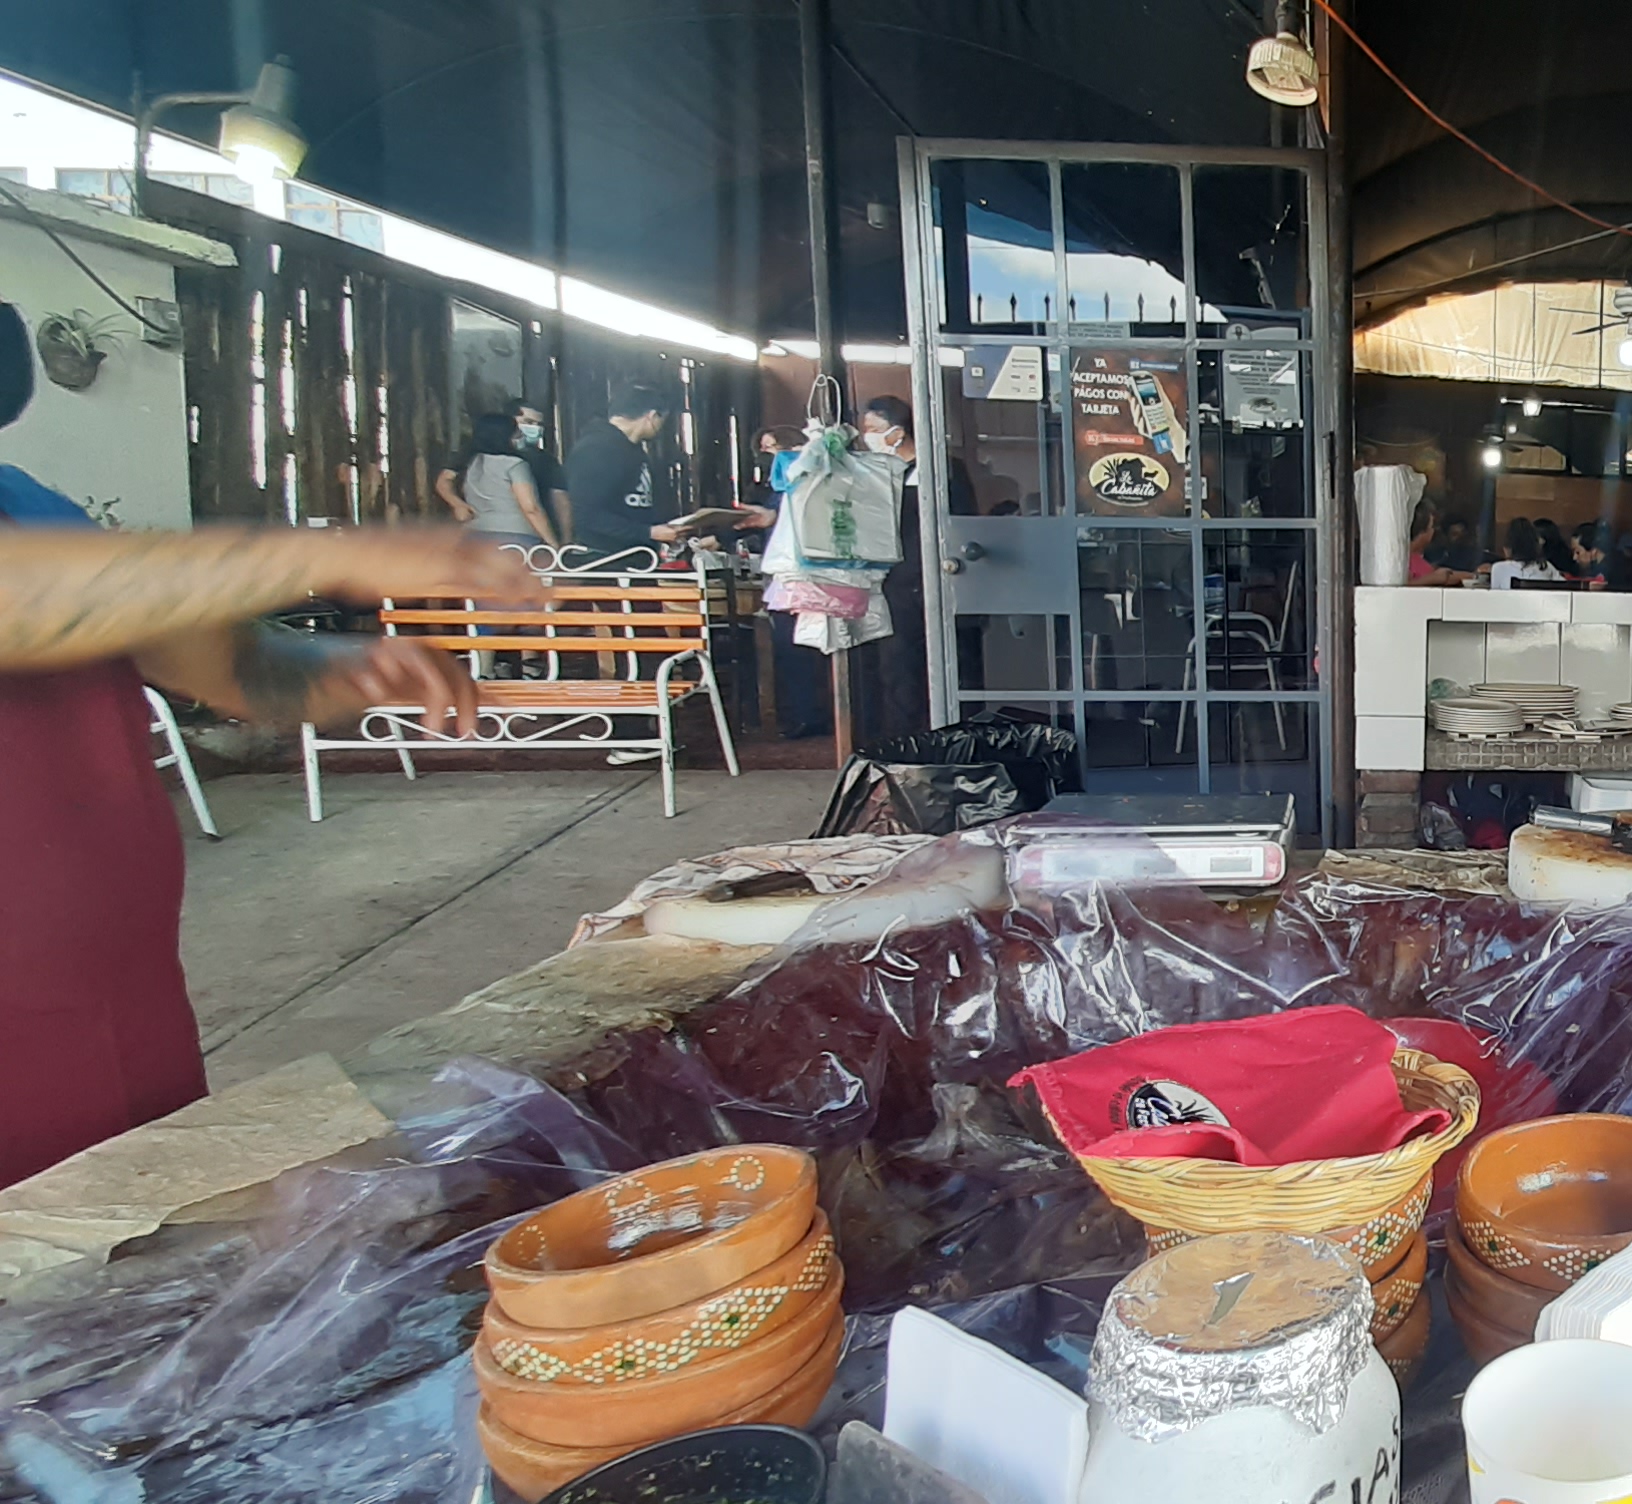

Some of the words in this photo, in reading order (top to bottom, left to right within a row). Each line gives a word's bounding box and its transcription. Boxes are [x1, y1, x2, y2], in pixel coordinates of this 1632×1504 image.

[1094, 358, 1107, 369] YA
[1073, 372, 1129, 386] ACEPTAMOS
[1107, 389, 1128, 401] CON
[1081, 403, 1120, 415] TARJETA
